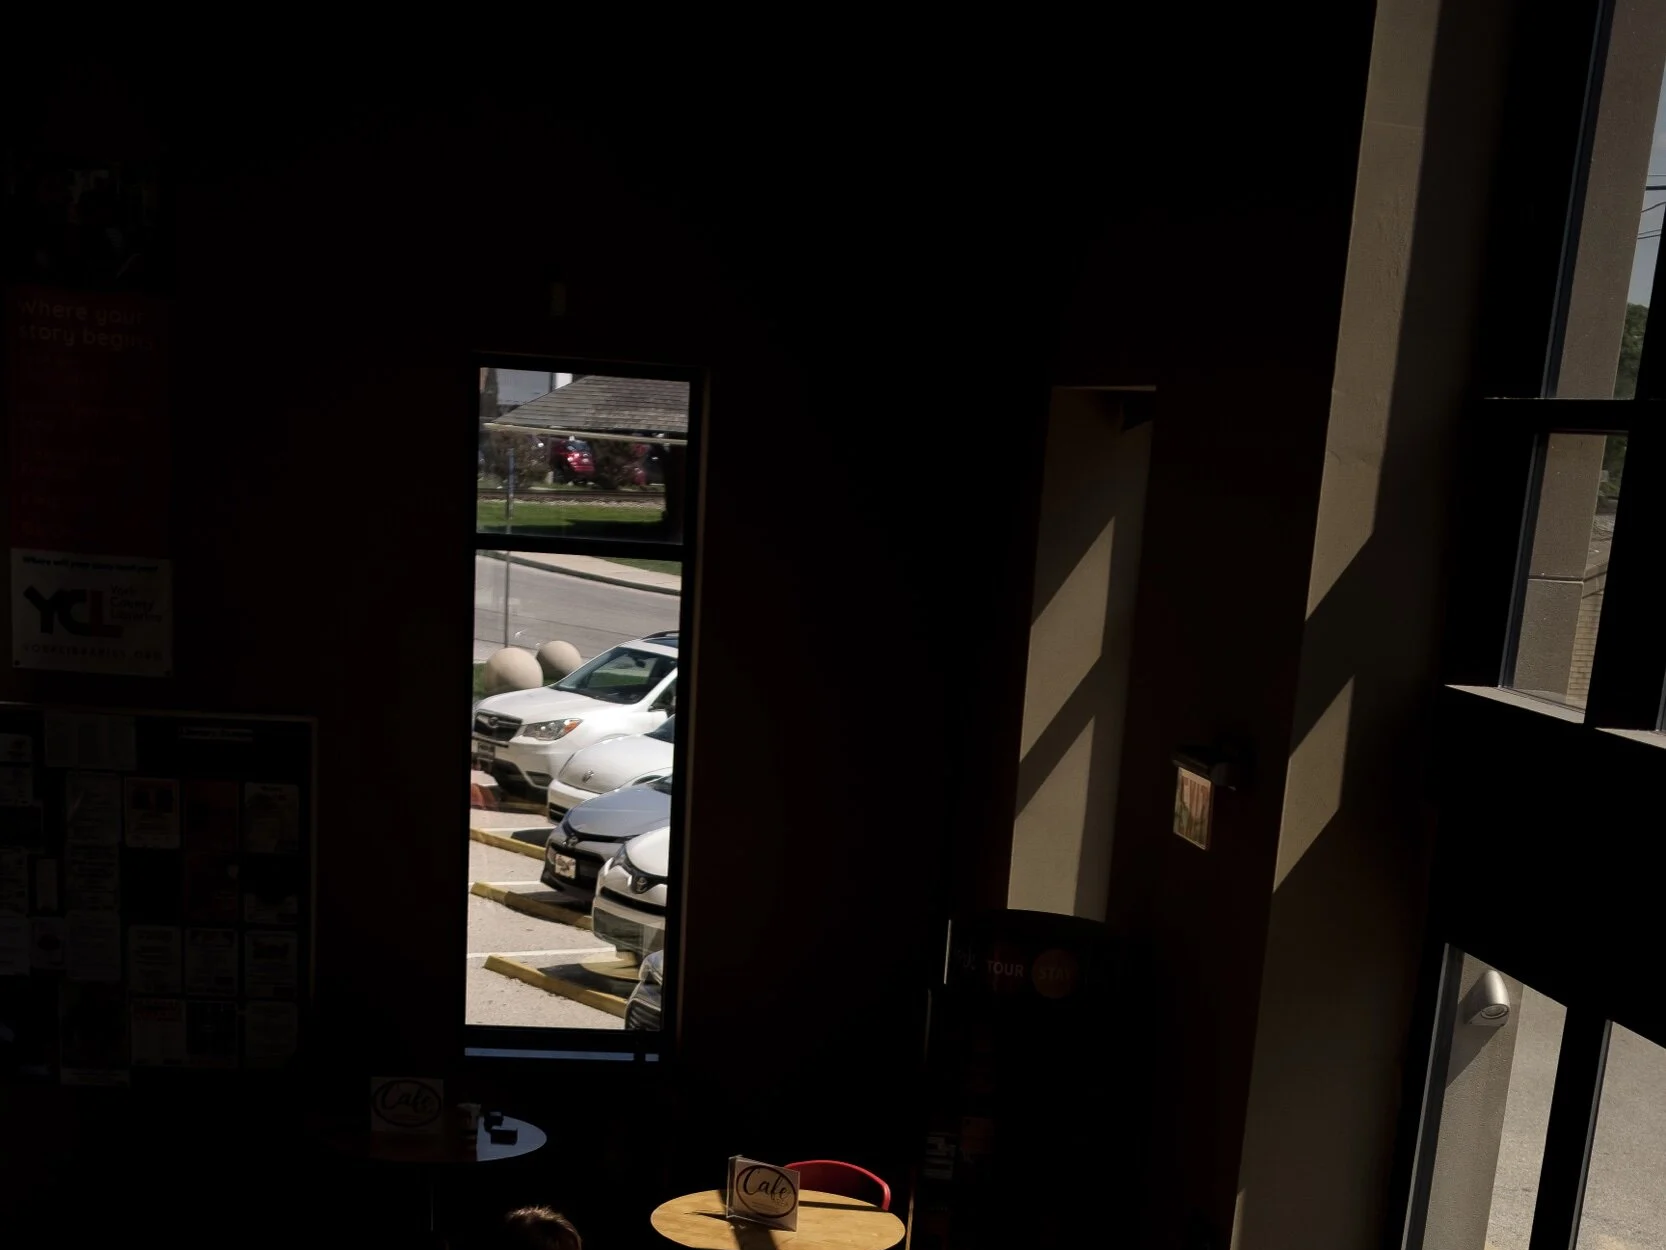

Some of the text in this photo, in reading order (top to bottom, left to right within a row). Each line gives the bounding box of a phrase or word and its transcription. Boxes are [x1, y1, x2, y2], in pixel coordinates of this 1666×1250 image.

[17, 298, 88, 321] Where
[23, 585, 124, 639] YCL
[987, 960, 1025, 978] TOUR
